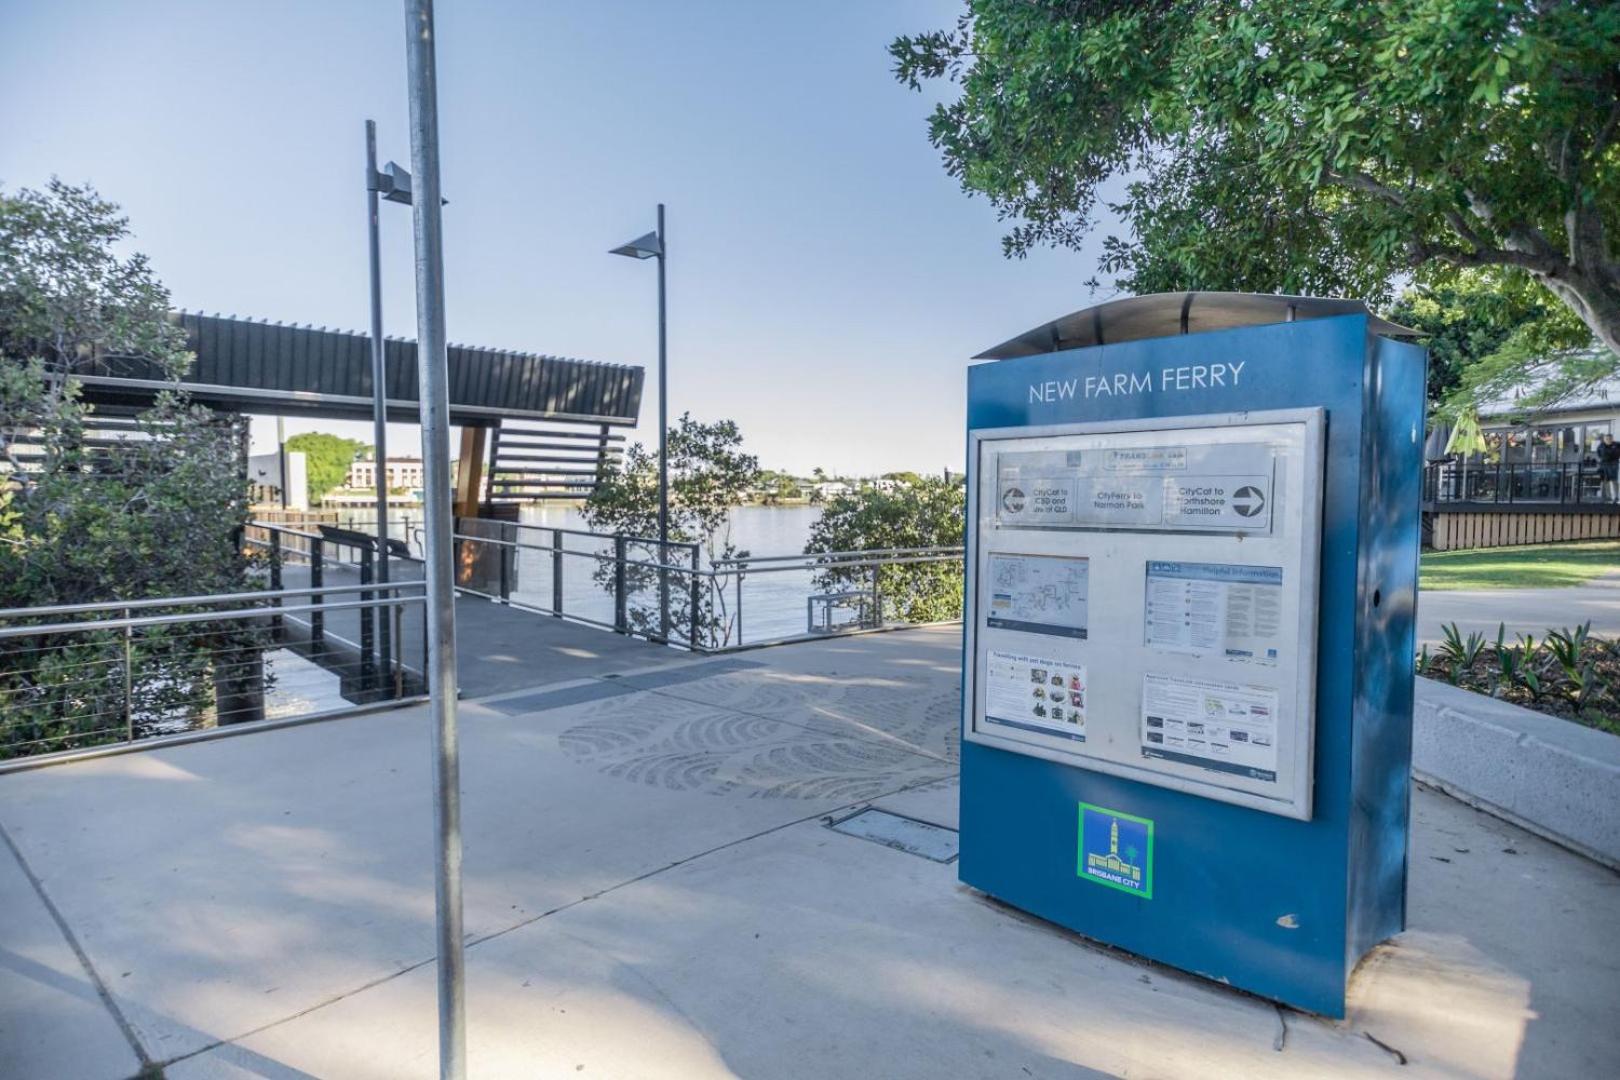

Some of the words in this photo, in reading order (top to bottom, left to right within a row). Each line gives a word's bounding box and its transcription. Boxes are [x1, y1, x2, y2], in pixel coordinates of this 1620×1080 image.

[1029, 379, 1077, 404] NEW
[1085, 371, 1152, 398] FARM
[1162, 361, 1245, 392] FERRY
[1179, 487, 1212, 497] CityCat
[1214, 487, 1225, 496] to
[1087, 866, 1122, 884] BRISBANE
[1122, 878, 1140, 889] CITY
